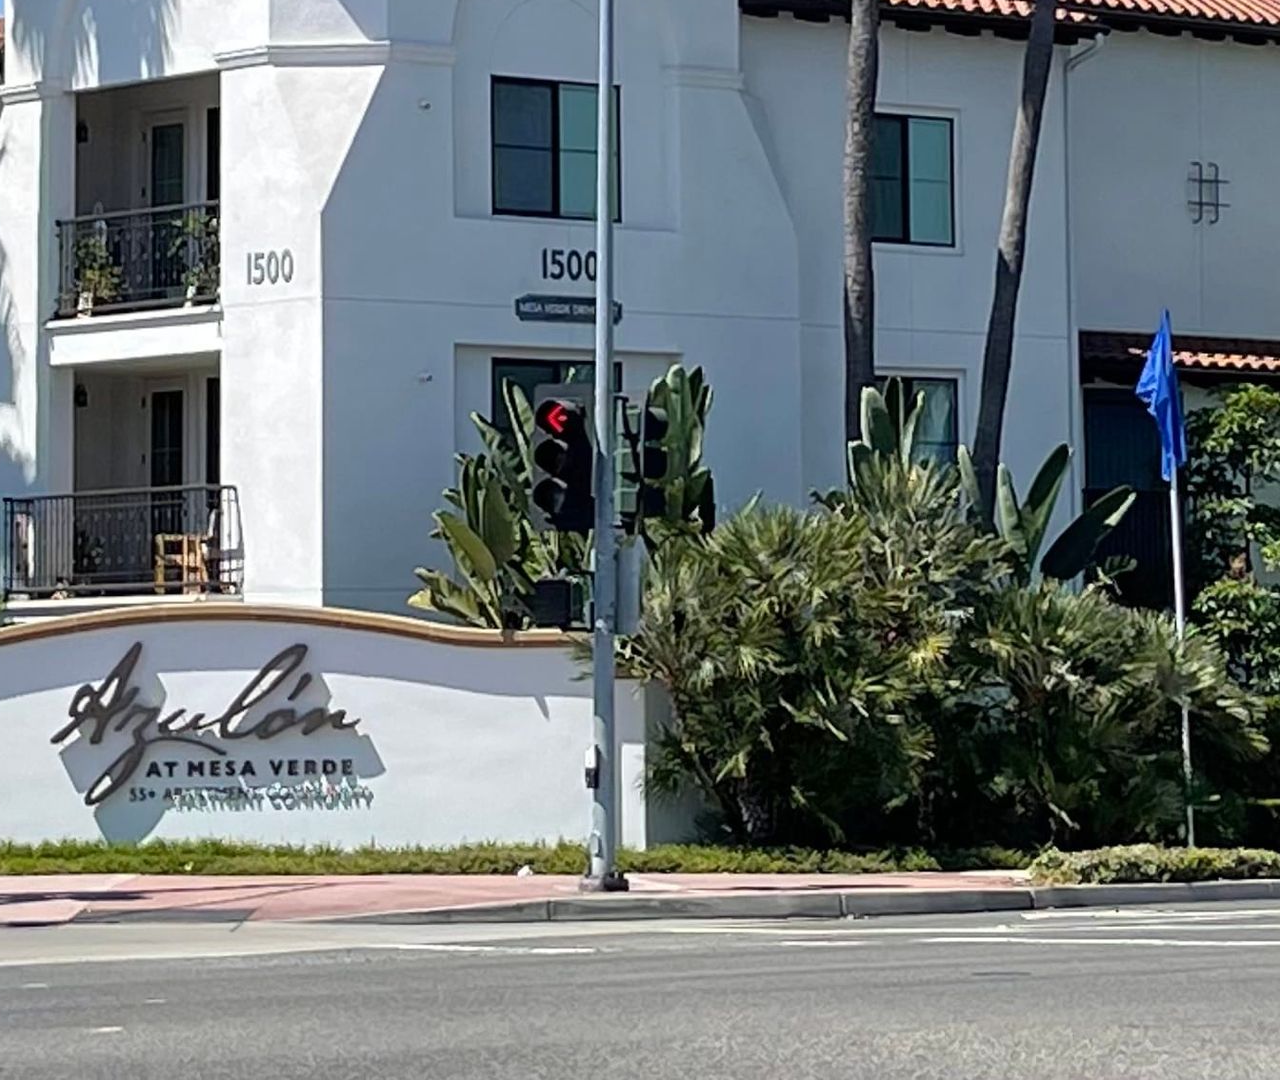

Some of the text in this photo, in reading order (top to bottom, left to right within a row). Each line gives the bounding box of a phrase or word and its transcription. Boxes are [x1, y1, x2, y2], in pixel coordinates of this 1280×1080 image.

[247, 248, 294, 285] 1500
[543, 248, 597, 281] 1500
[146, 759, 354, 777] AT MESA VERDE
